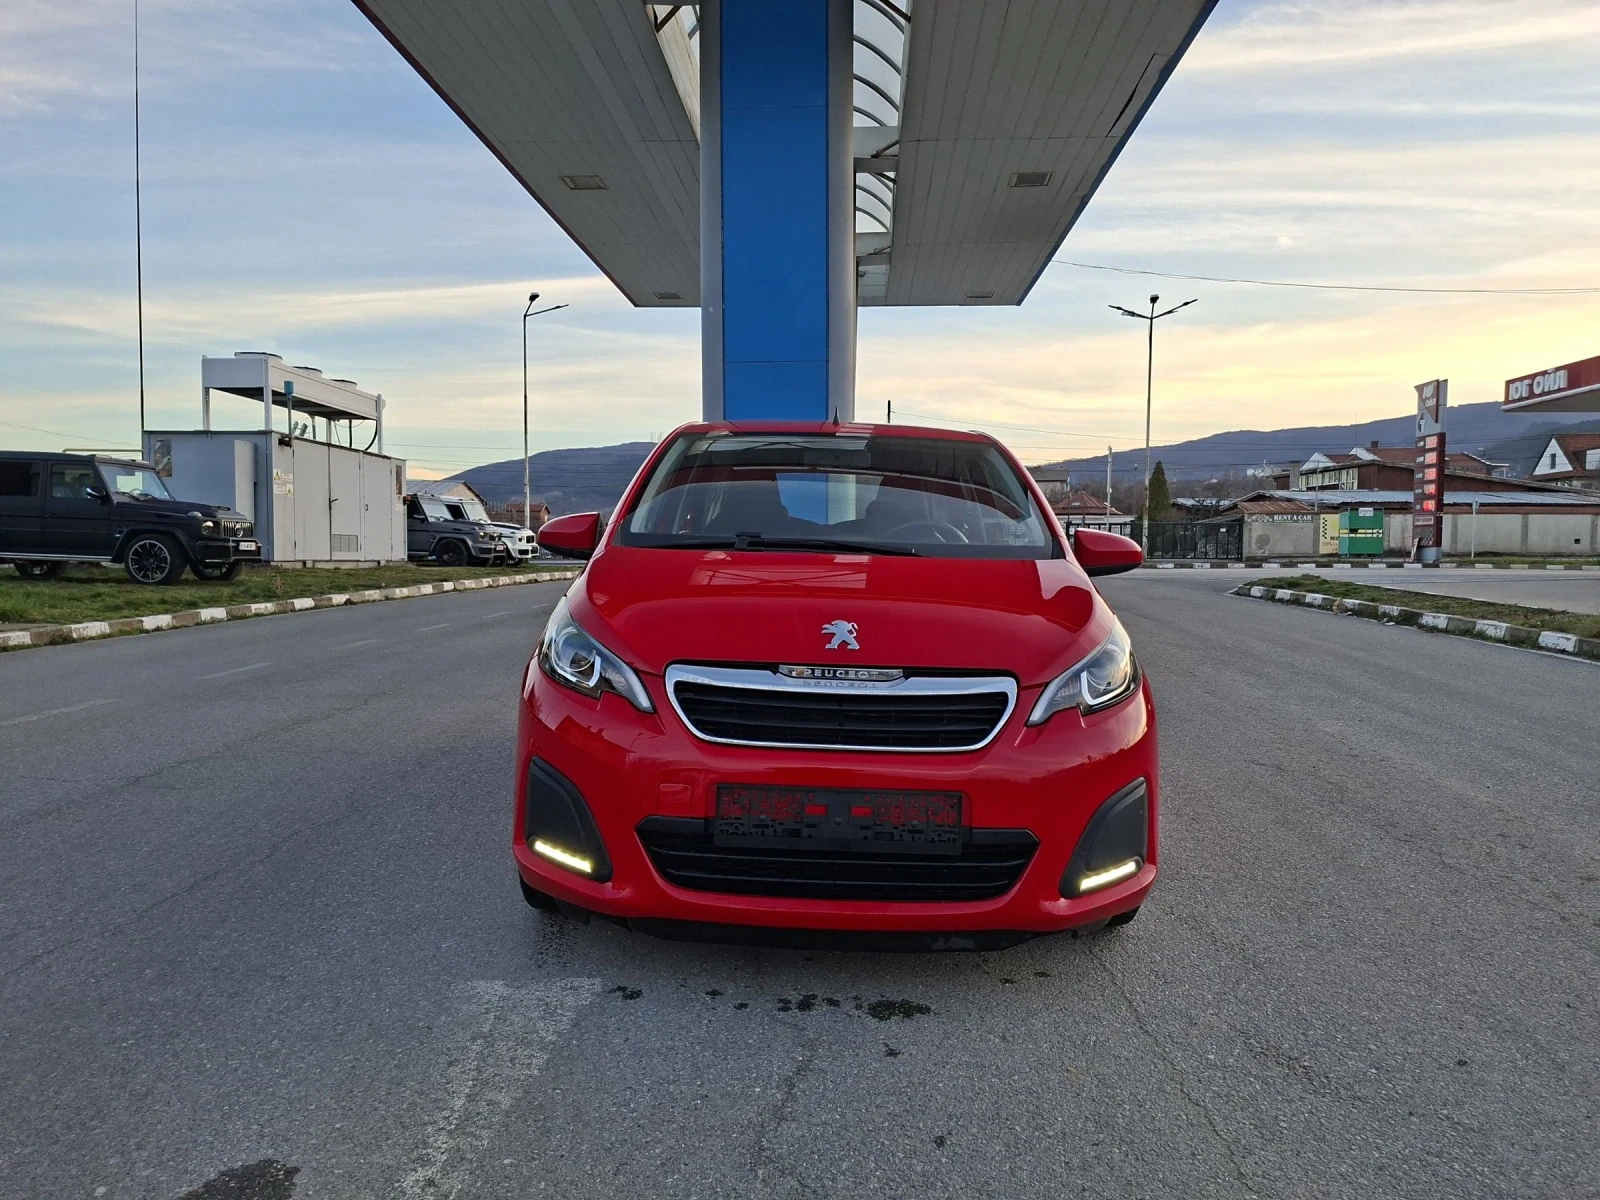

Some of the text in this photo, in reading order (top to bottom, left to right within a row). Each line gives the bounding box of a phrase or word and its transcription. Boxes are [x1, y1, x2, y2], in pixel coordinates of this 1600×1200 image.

[1509, 368, 1568, 400] ЮГ ОЙЛ
[803, 669, 879, 679] PEUGEOT
